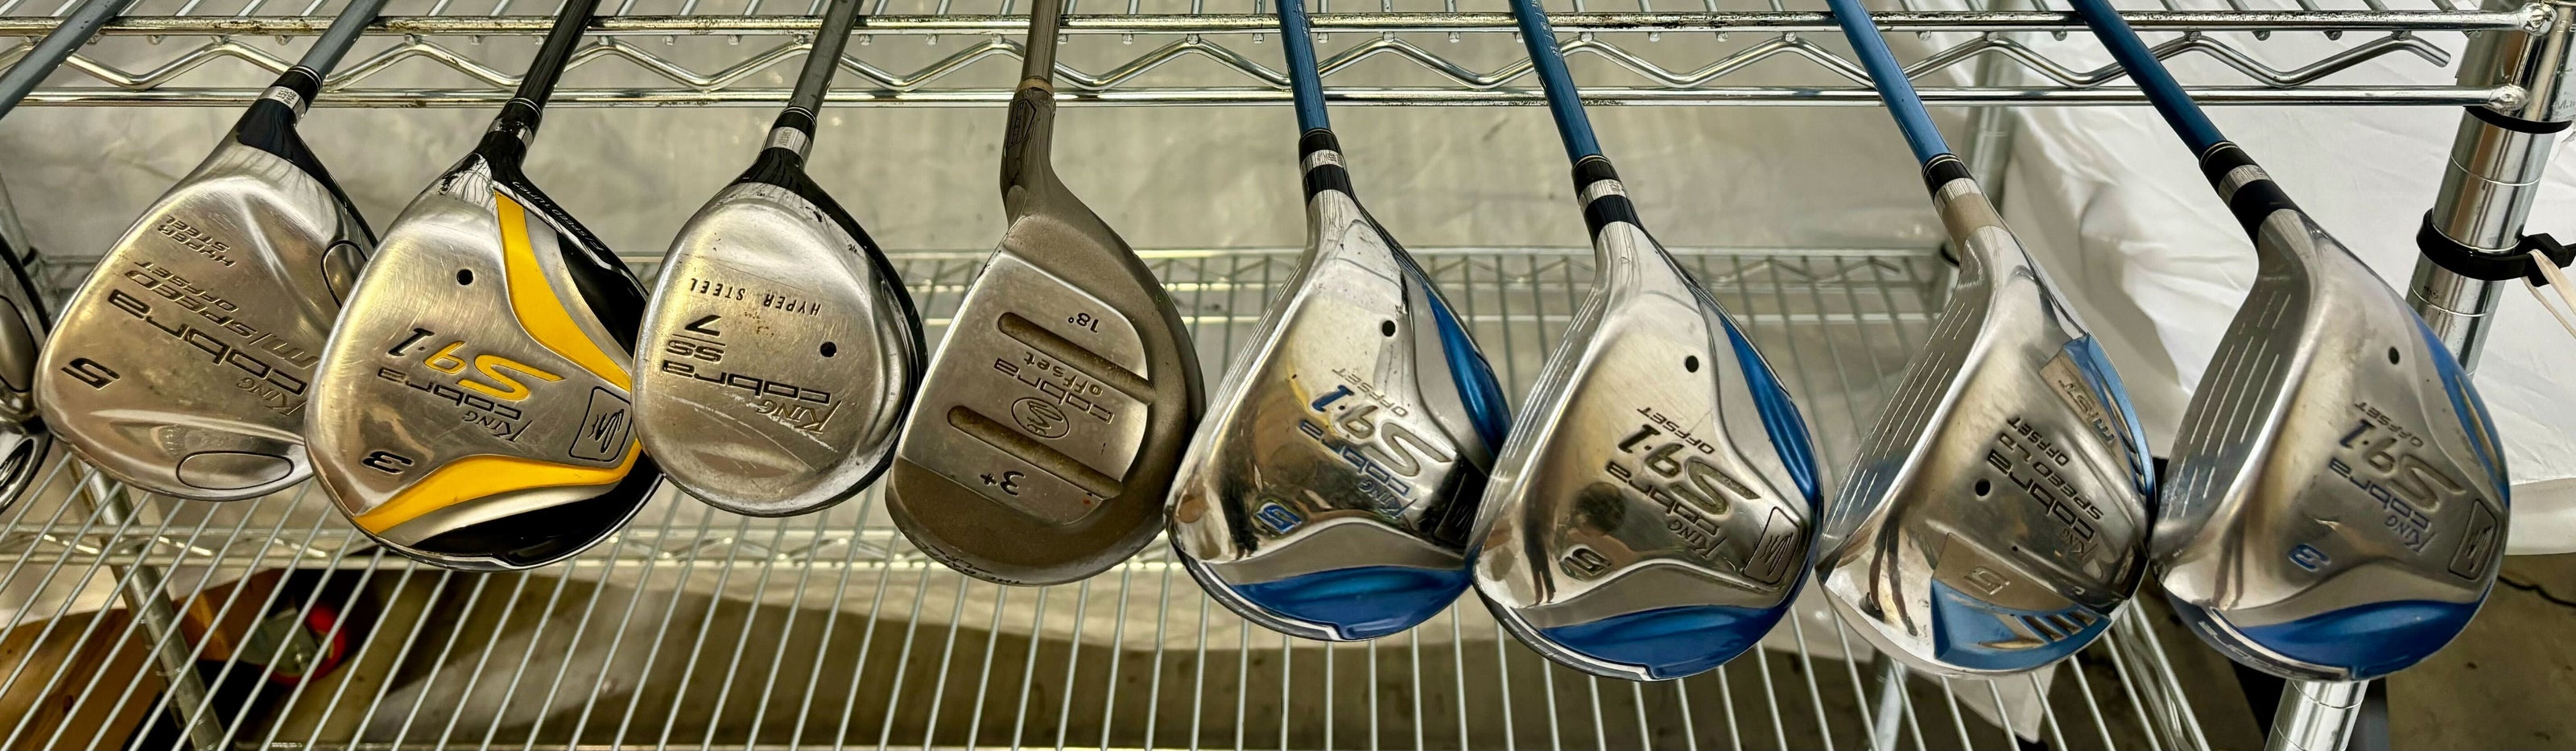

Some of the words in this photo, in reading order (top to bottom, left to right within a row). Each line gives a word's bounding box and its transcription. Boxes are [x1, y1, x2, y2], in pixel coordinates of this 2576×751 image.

[158, 225, 236, 267] HYPER
[165, 215, 230, 253] STEEL
[134, 262, 238, 312] OFFSET
[690, 279, 745, 301] STEEL
[764, 294, 821, 316] HYPER
[108, 289, 307, 396] cobra
[684, 315, 721, 337] 7
[62, 357, 121, 390] 5
[666, 340, 724, 362] SS
[1024, 351, 1103, 396] offset
[378, 367, 522, 421] cobra
[663, 360, 832, 406] cobra
[994, 357, 1115, 425] cobra
[1332, 367, 1408, 417] OFFSET
[1637, 406, 1715, 455] OFFSET
[2007, 415, 2070, 467] OFFSET
[2355, 402, 2423, 448] OFFSET
[362, 451, 414, 474] 3
[1299, 419, 1410, 496] cobra
[980, 471, 1025, 496] 3+
[1605, 460, 1719, 536] cobra
[1988, 448, 2095, 543] cobra
[2033, 461, 2103, 521] SPEED
[2329, 457, 2431, 533] cobra
[1256, 502, 1302, 534] 5
[2287, 543, 2331, 572] 3
